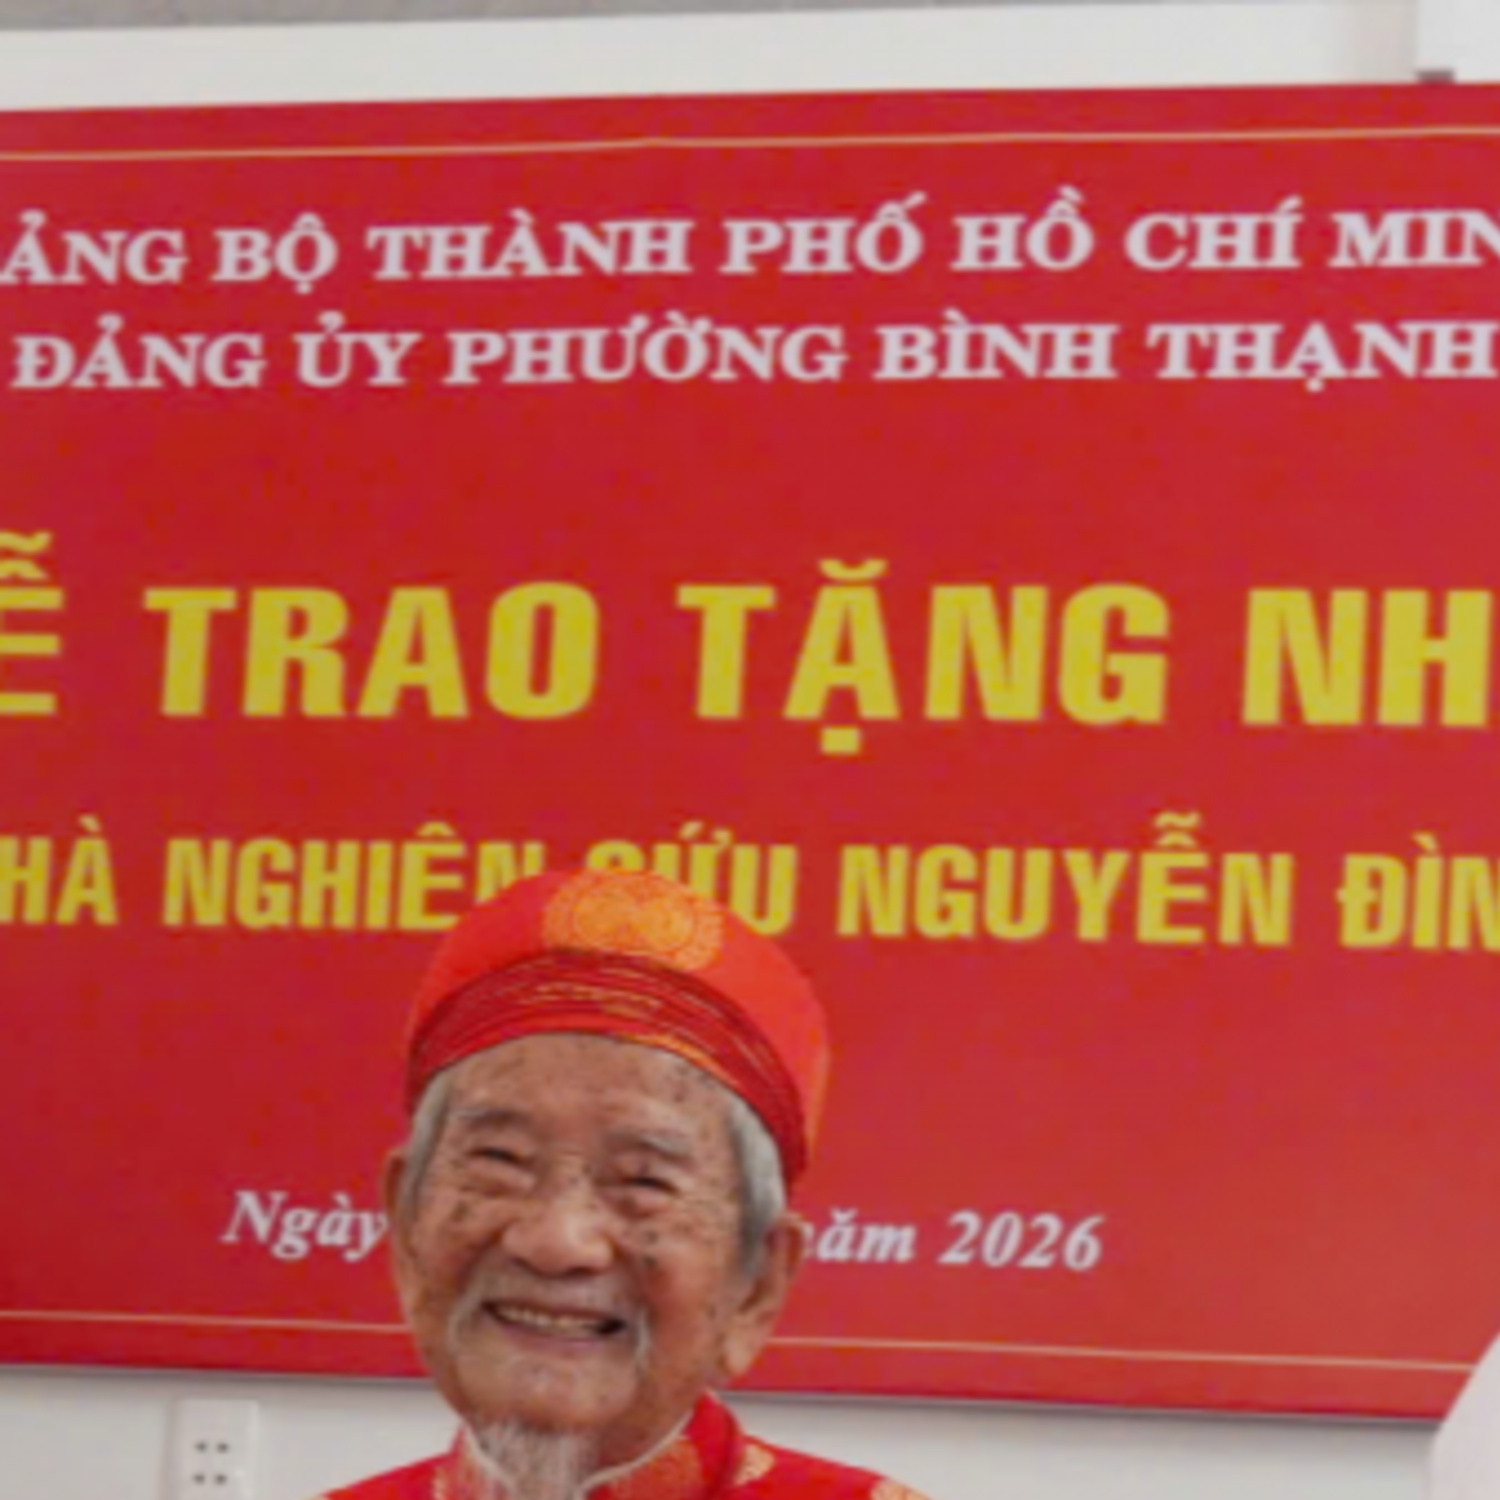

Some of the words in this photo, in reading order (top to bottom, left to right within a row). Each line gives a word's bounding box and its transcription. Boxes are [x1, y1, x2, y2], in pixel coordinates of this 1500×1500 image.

[211, 212, 338, 295] BỘ
[365, 208, 695, 281] THÀNH
[719, 191, 926, 274] PHỐ
[951, 185, 1095, 271] HỒ
[1124, 195, 1303, 271] CHÍ
[11, 313, 266, 389] ĐẢNG
[293, 310, 422, 388] ỦY
[443, 310, 848, 385] PHƯỜNG
[873, 307, 1119, 380] BÌNH
[144, 581, 599, 720] TRAO
[677, 558, 1170, 755] TẶNG
[836, 811, 1295, 947] NGUYỄN
[219, 1190, 389, 1263] Ngày
[936, 1209, 1105, 1271] 2026
